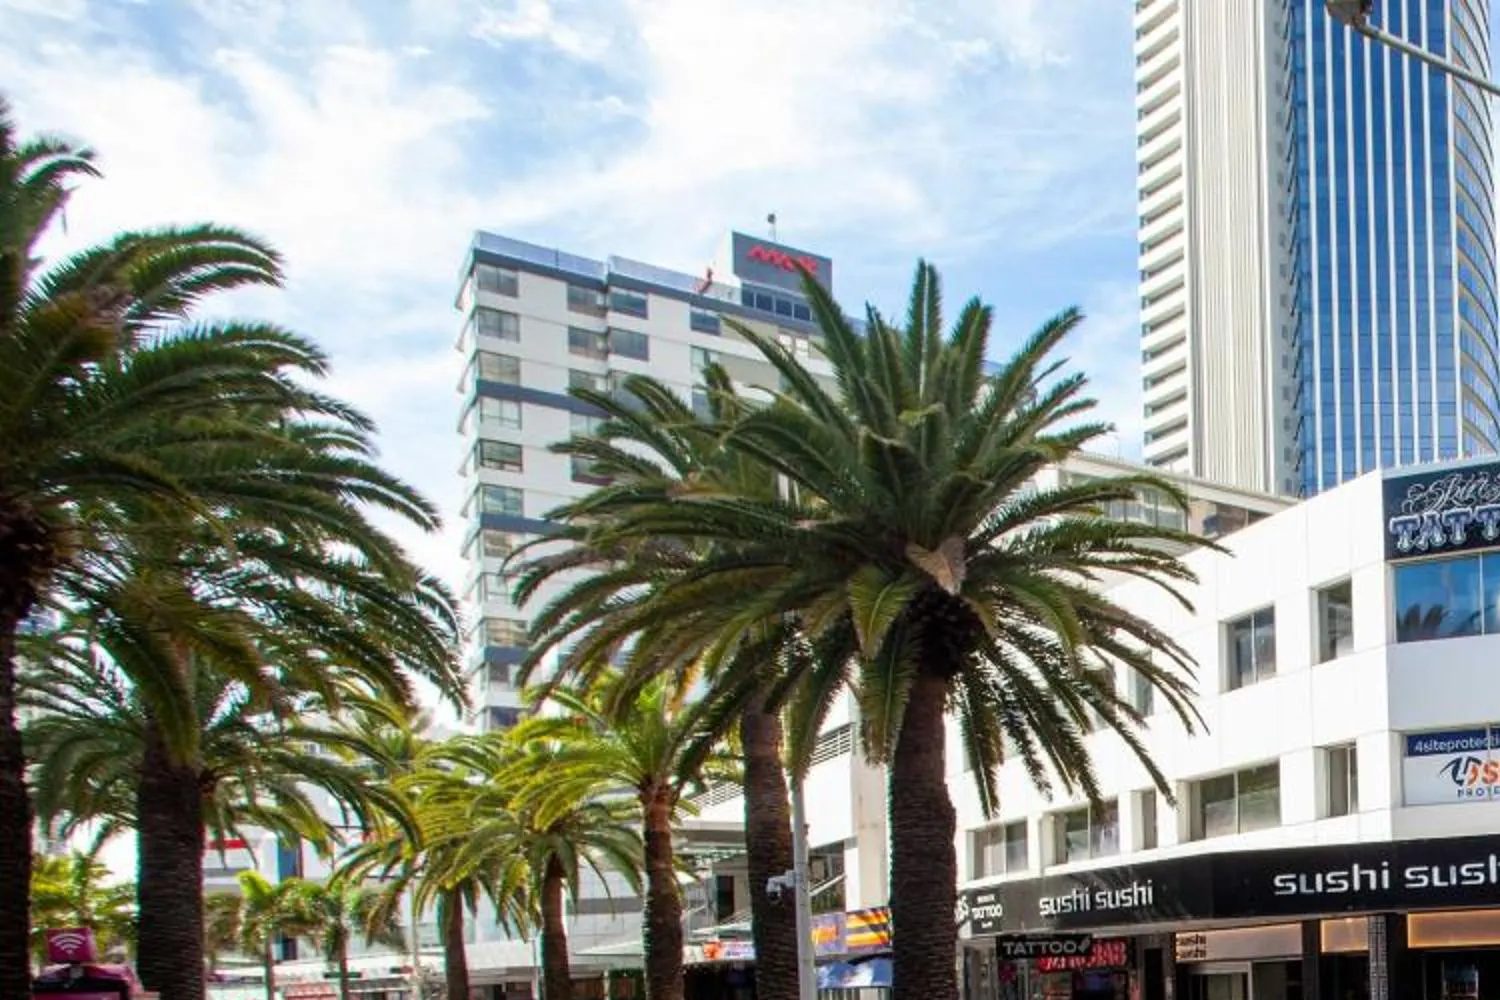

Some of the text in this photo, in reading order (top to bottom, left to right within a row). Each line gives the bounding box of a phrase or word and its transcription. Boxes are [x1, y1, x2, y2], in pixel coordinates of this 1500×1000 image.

[1273, 861, 1391, 896] sushi
[1039, 880, 1153, 917] sushi sushi
[1002, 940, 1077, 956] TATTOO
